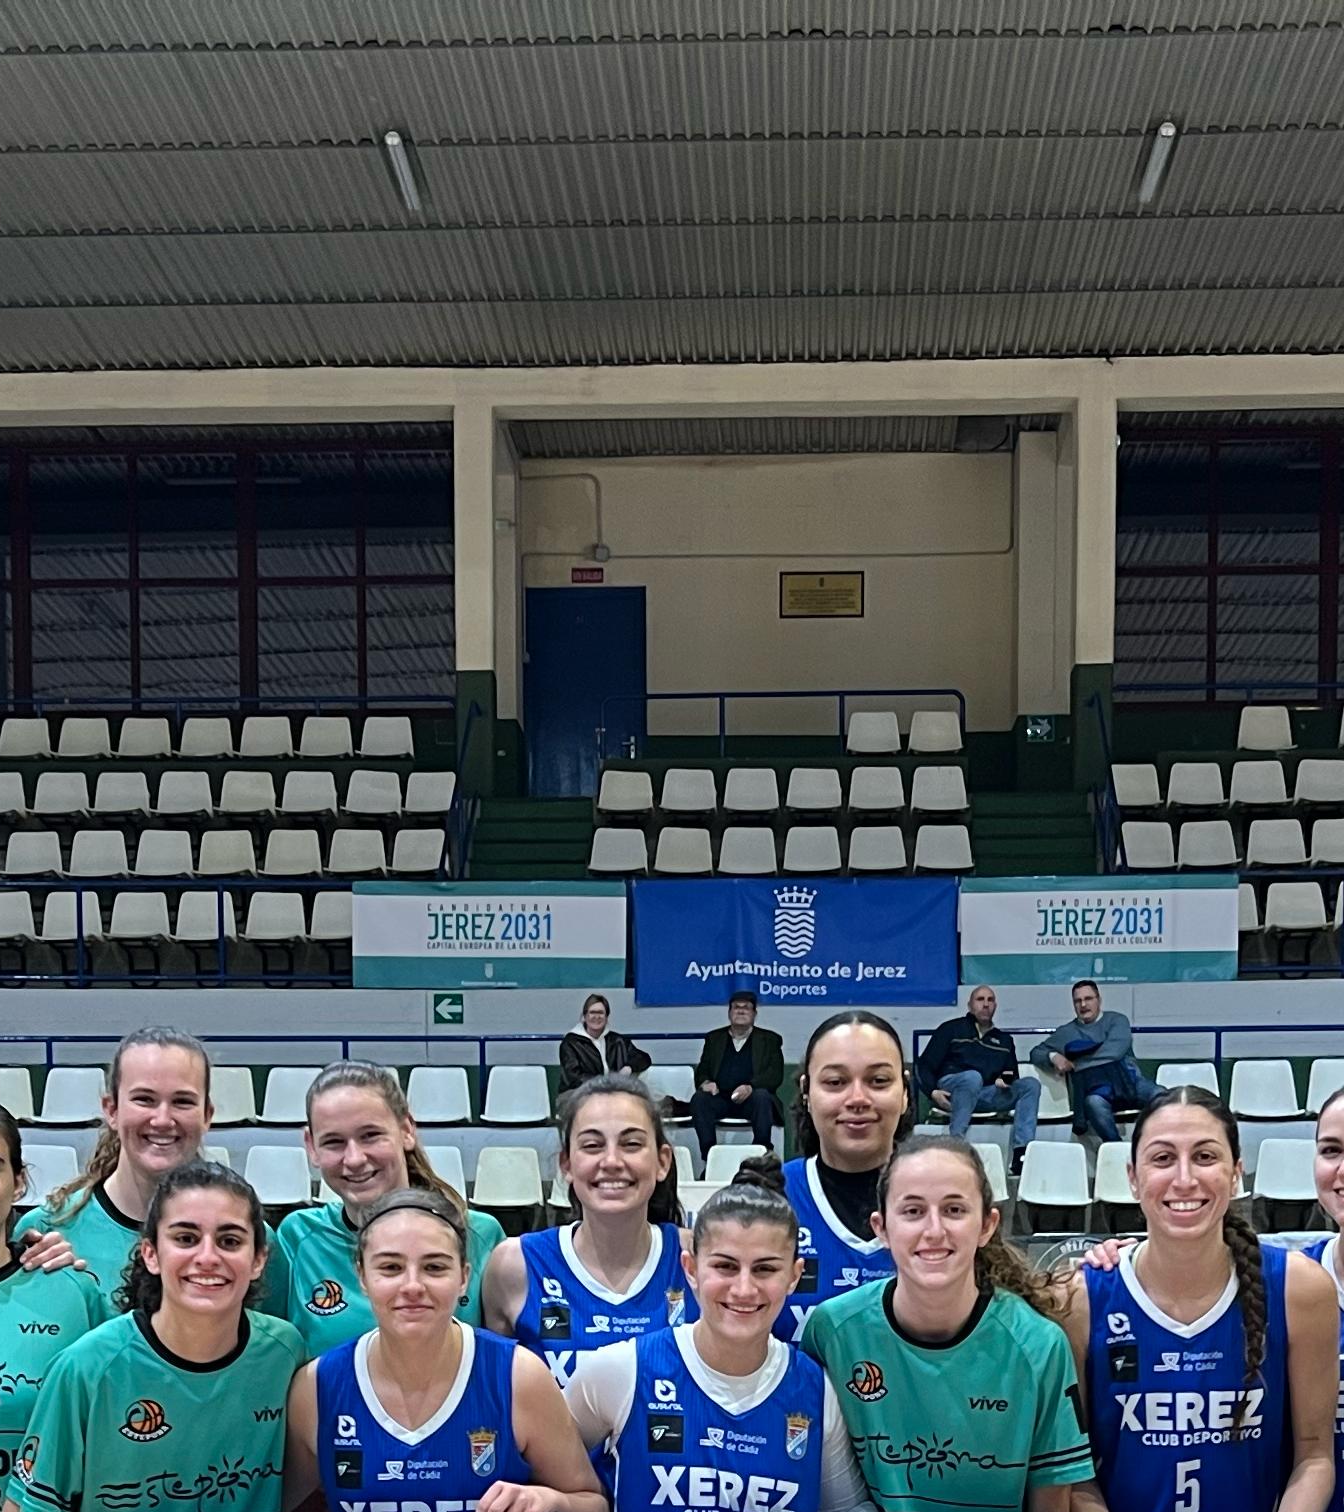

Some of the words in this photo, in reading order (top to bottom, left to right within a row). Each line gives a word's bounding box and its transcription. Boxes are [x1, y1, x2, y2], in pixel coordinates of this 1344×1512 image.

[427, 903, 551, 912] CANDIDATURA
[1037, 898, 1163, 907] CANDIDATURA
[427, 913, 496, 941] JEREZ
[501, 913, 552, 941] 2031
[1037, 908, 1106, 936] JEREZ
[1112, 907, 1163, 935] 2031
[427, 942, 456, 950] CAPITAL
[459, 942, 493, 950] EUROPEA
[495, 942, 504, 950] DE
[507, 942, 516, 950] LA
[519, 942, 551, 950] CULTURA
[1035, 938, 1065, 946] CAPITAL
[1069, 937, 1103, 946] EUROPEA
[1130, 936, 1163, 944] CULTURA
[685, 960, 822, 982] Ayuntamiento
[827, 962, 851, 978] de
[855, 962, 906, 982] Jerez
[759, 981, 827, 999] Deportes
[18, 1320, 60, 1336] vive
[1183, 1351, 1223, 1361] Diputación
[1183, 1363, 1194, 1371] de
[1195, 1362, 1217, 1371] Cádiz
[968, 1395, 1009, 1411] vive
[1115, 1388, 1264, 1432] XEREZ
[254, 1405, 283, 1423] viv
[726, 1430, 767, 1445] Diputación
[1142, 1431, 1179, 1446] CLUB
[1183, 1427, 1262, 1446] DEPORIVO
[407, 1460, 448, 1471] Diputación
[407, 1471, 417, 1480] de
[419, 1469, 441, 1480] Cádiz
